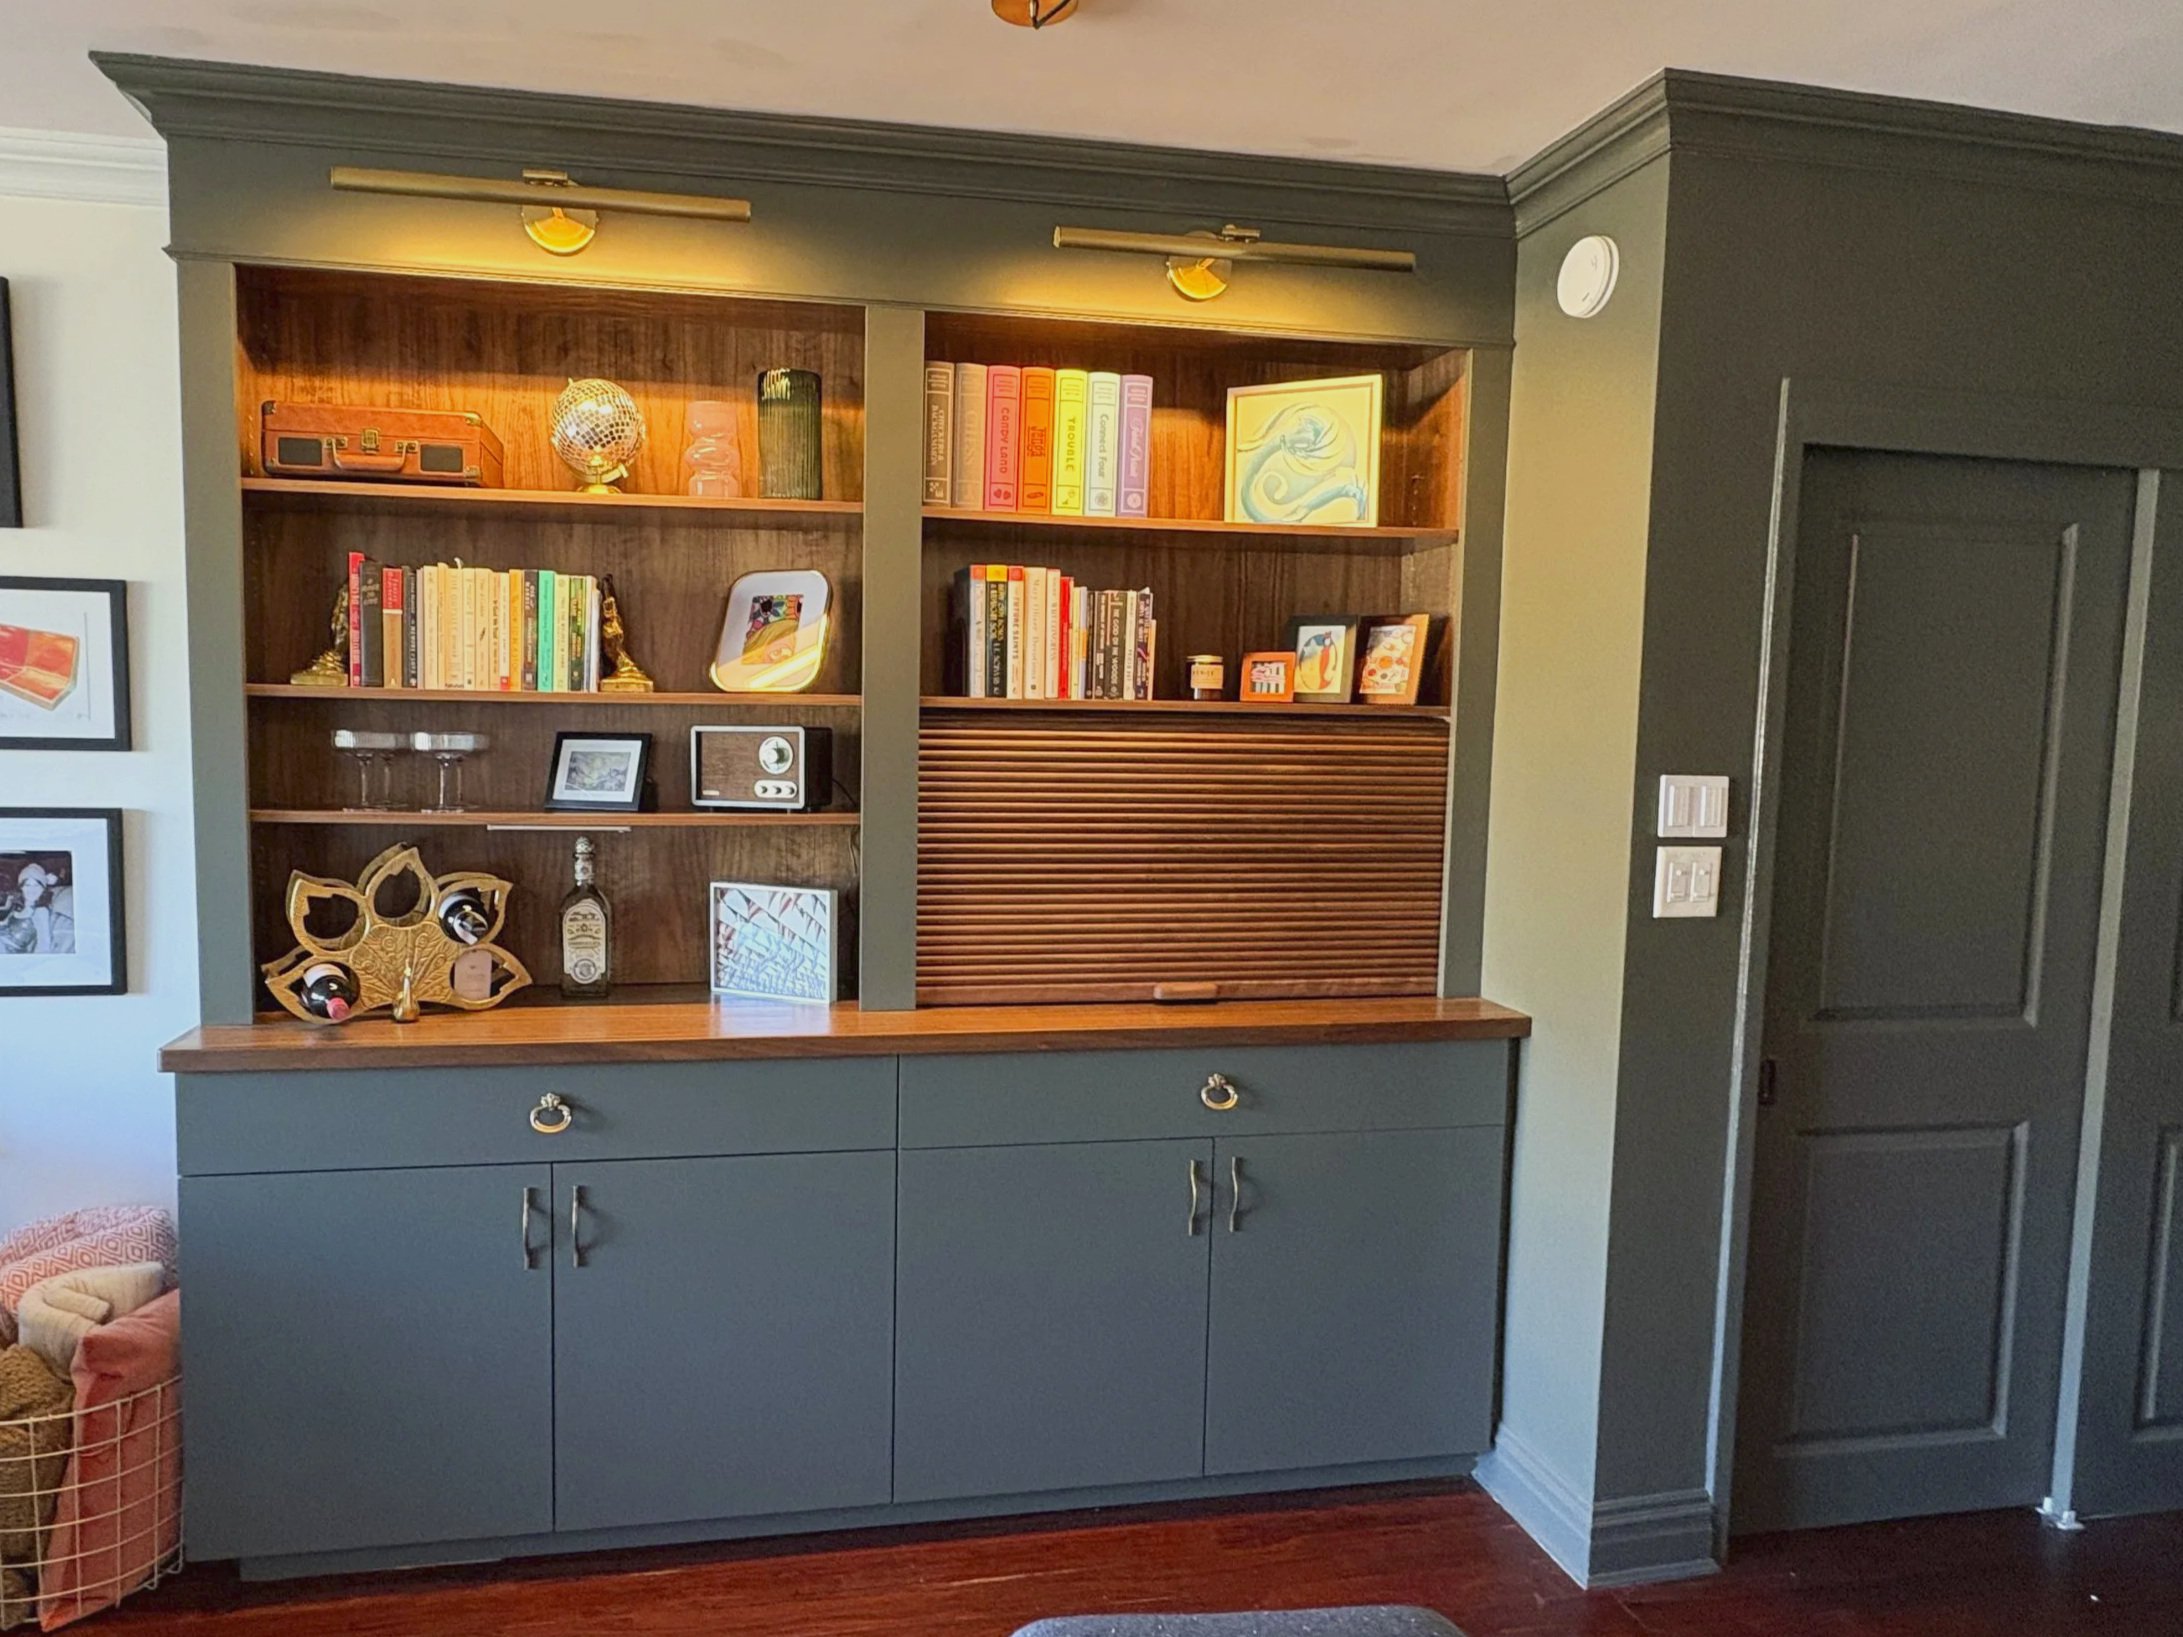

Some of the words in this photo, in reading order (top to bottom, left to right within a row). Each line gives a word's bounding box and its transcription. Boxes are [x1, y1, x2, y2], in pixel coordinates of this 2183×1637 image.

[966, 410, 979, 465] CHESS
[1027, 426, 1047, 457] Jenga
[1066, 417, 1076, 472] TROUBLE
[1098, 414, 1109, 453] Connect
[1098, 455, 1107, 478] Four
[1112, 637, 1119, 646] OF
